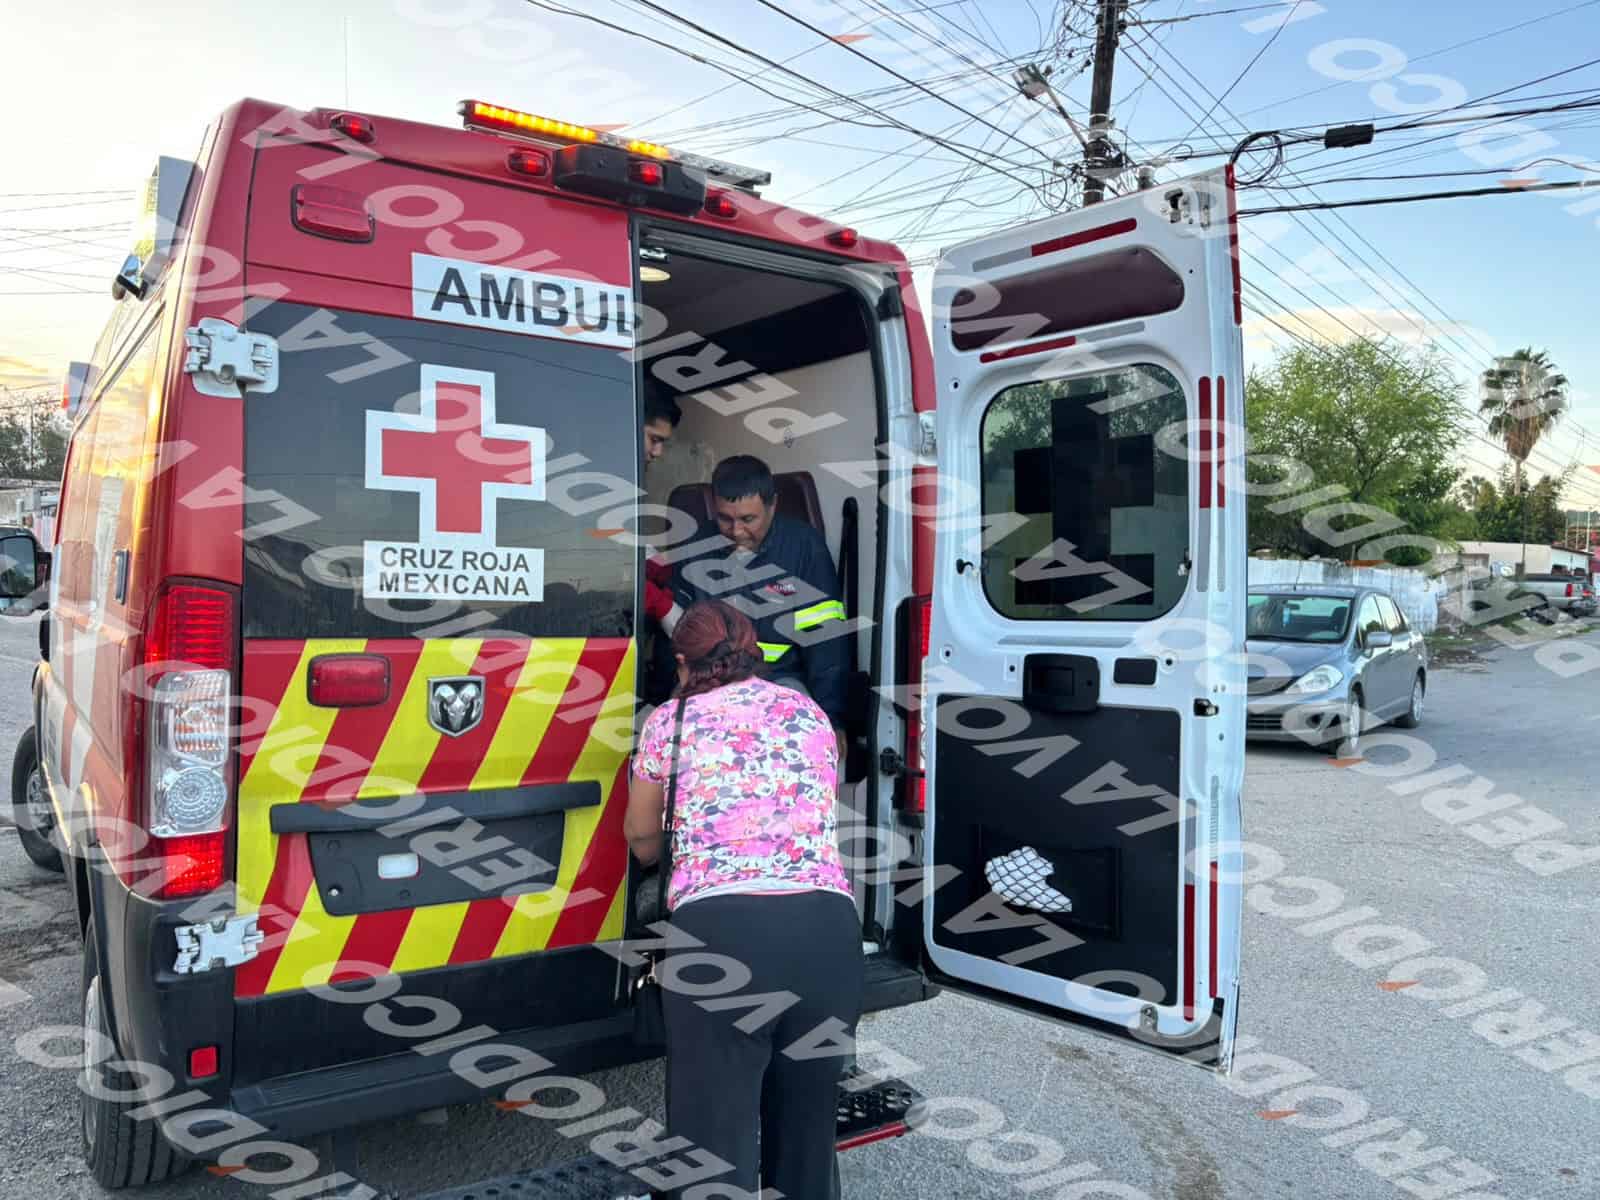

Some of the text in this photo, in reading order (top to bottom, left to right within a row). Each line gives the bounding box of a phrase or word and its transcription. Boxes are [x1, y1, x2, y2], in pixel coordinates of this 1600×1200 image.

[431, 267, 635, 338] AMBUL
[381, 547, 530, 573] CRUZ ROJA
[379, 572, 530, 597] MEXICANA
